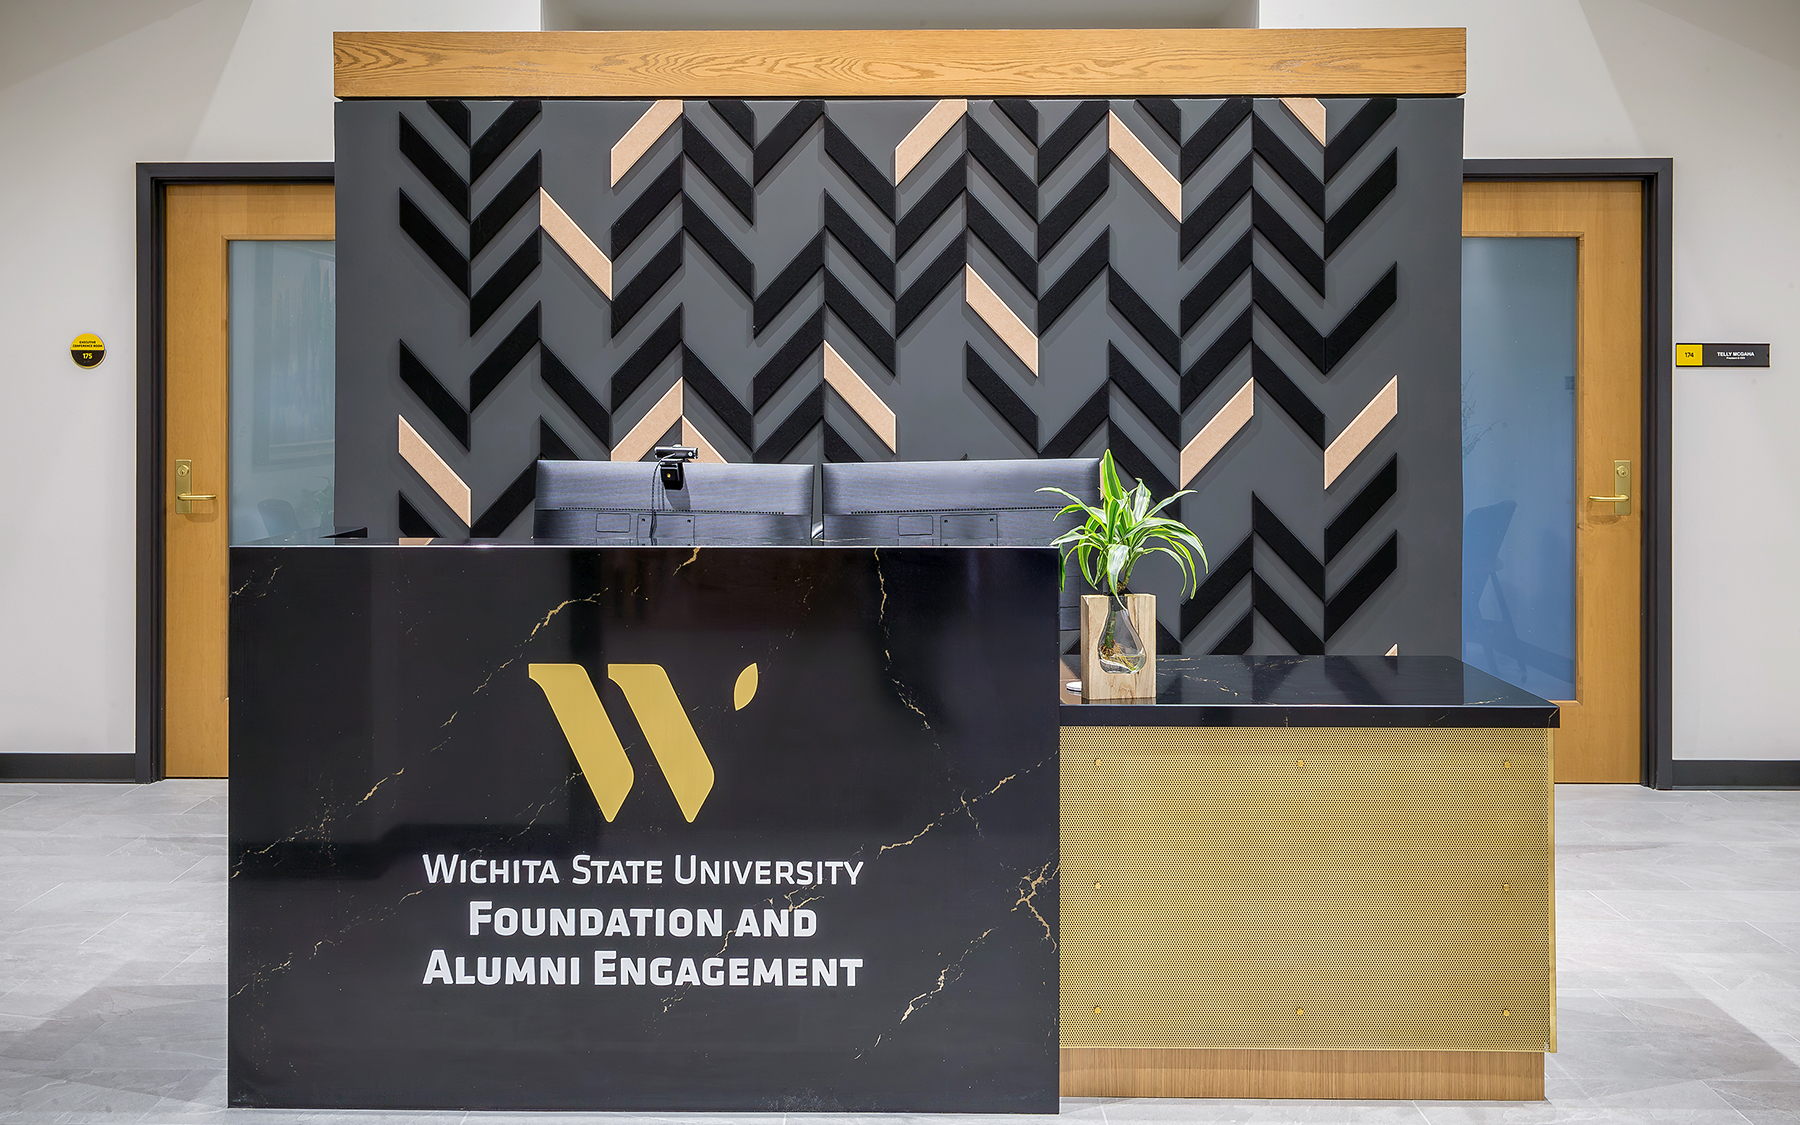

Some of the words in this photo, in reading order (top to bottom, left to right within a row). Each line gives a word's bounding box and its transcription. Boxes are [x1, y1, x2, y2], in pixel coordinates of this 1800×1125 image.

[82, 352, 93, 360] 175
[423, 853, 560, 885] WICHITA
[571, 854, 663, 886] STATE
[674, 854, 864, 886] UNIVERSITY
[469, 900, 723, 938] FOUNDATION
[734, 907, 818, 938] AND
[422, 949, 580, 986] ALUMNI
[594, 950, 864, 987] ENGAGEMENT
